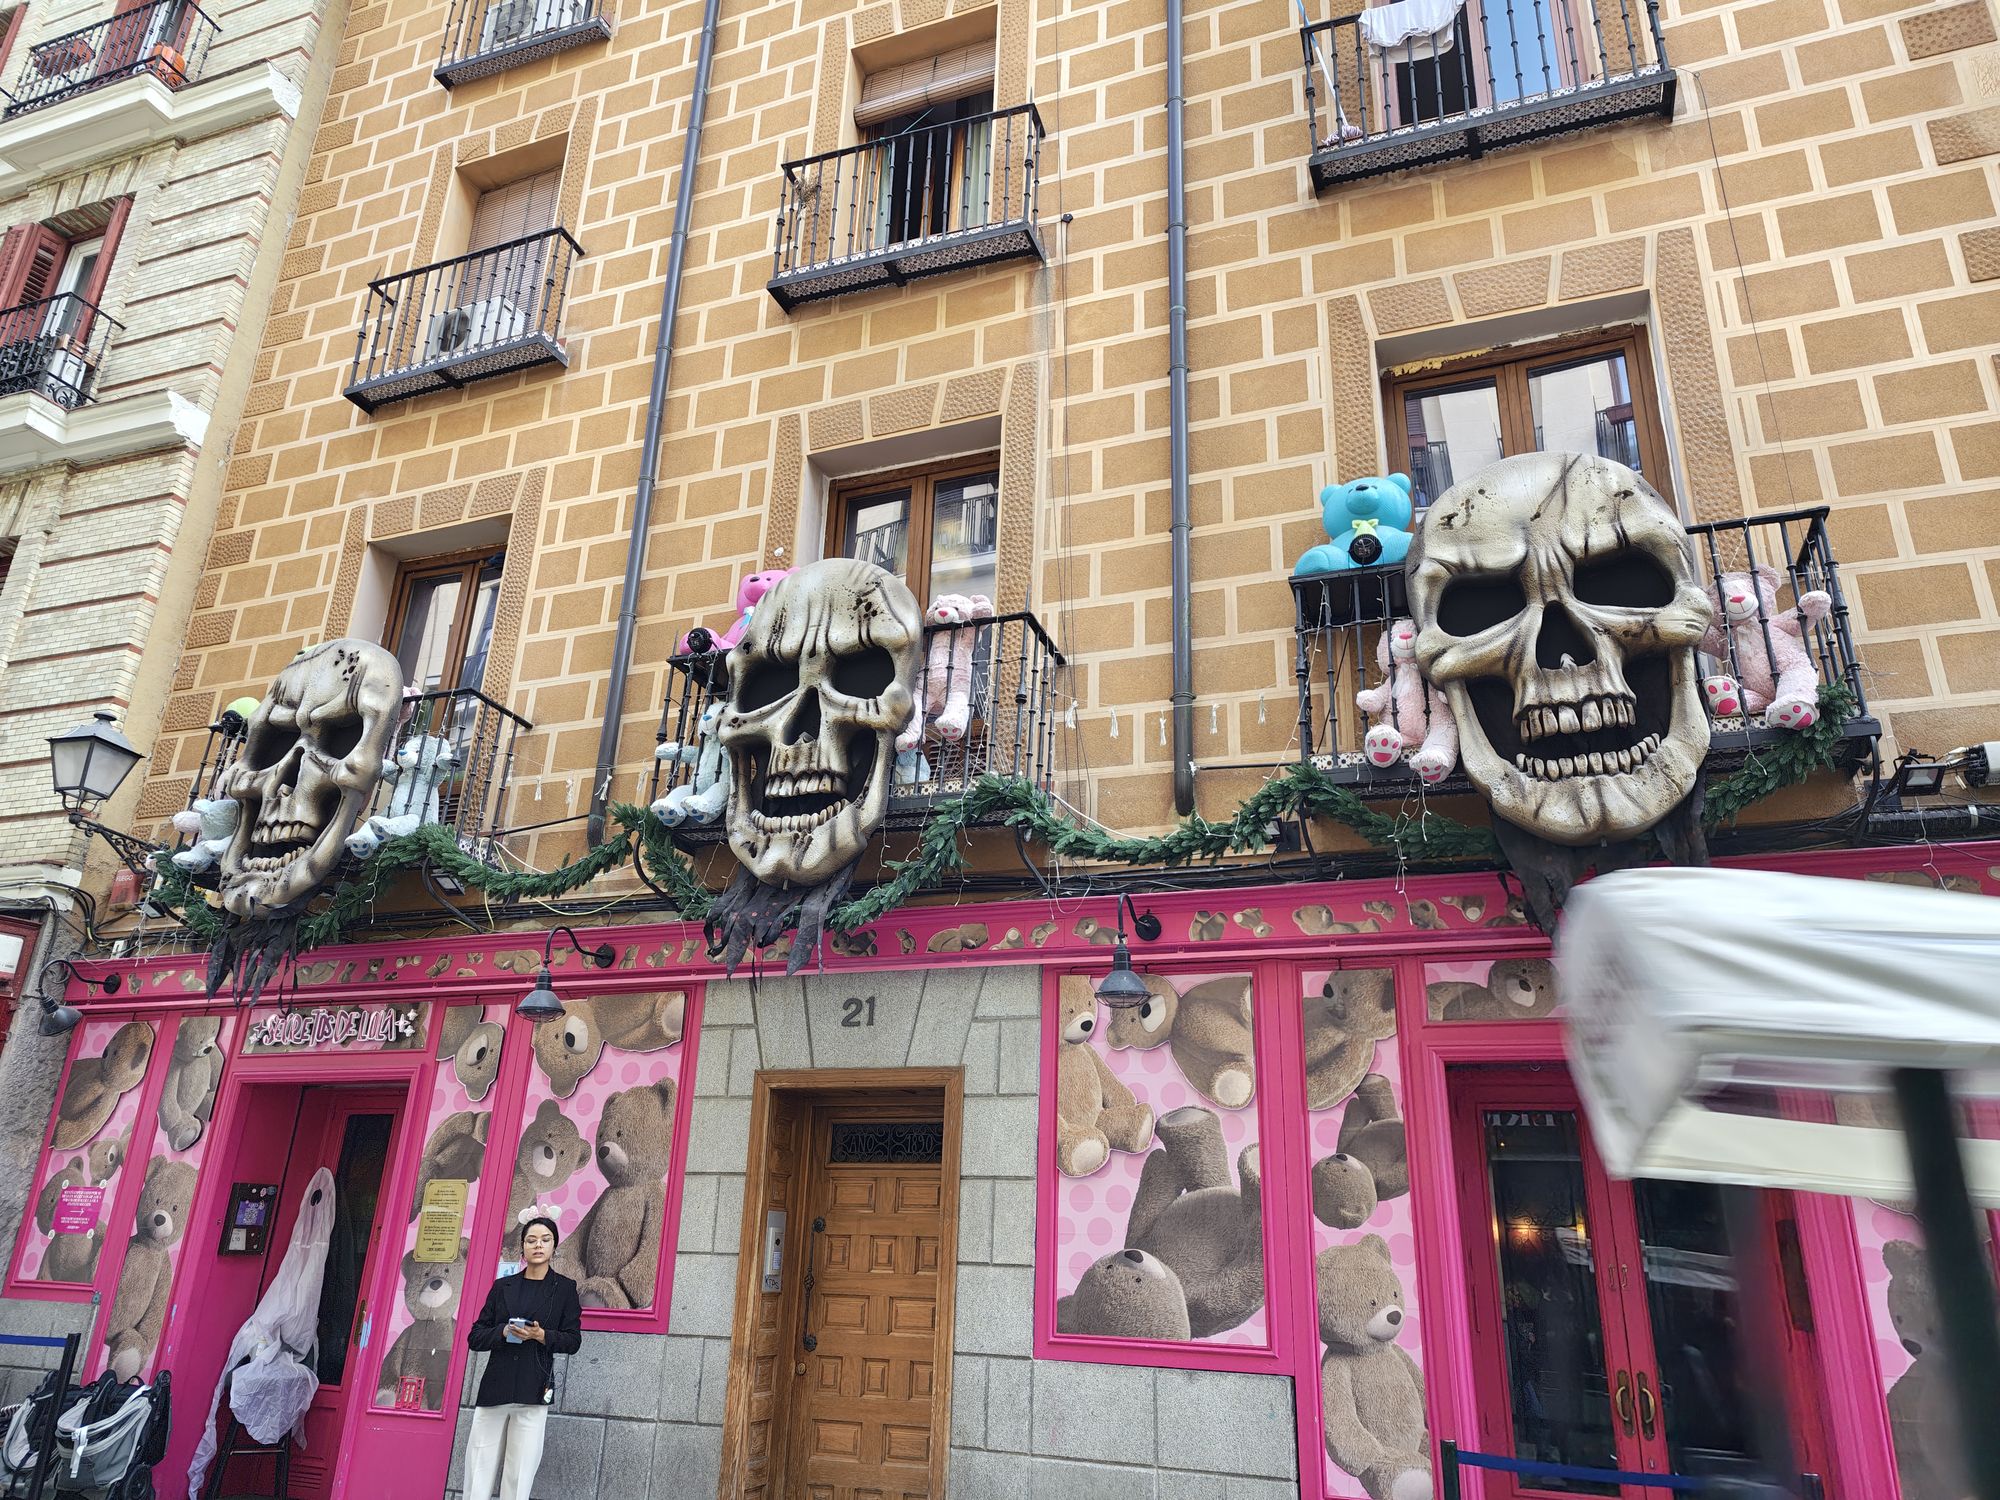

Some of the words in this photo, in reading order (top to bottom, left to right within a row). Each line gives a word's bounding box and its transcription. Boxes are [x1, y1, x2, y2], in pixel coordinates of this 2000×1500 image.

[332, 1010, 360, 1044] DE
[357, 1008, 396, 1042] LOLA
[841, 996, 875, 1027] 21
[905, 1134, 935, 1154] 1890
